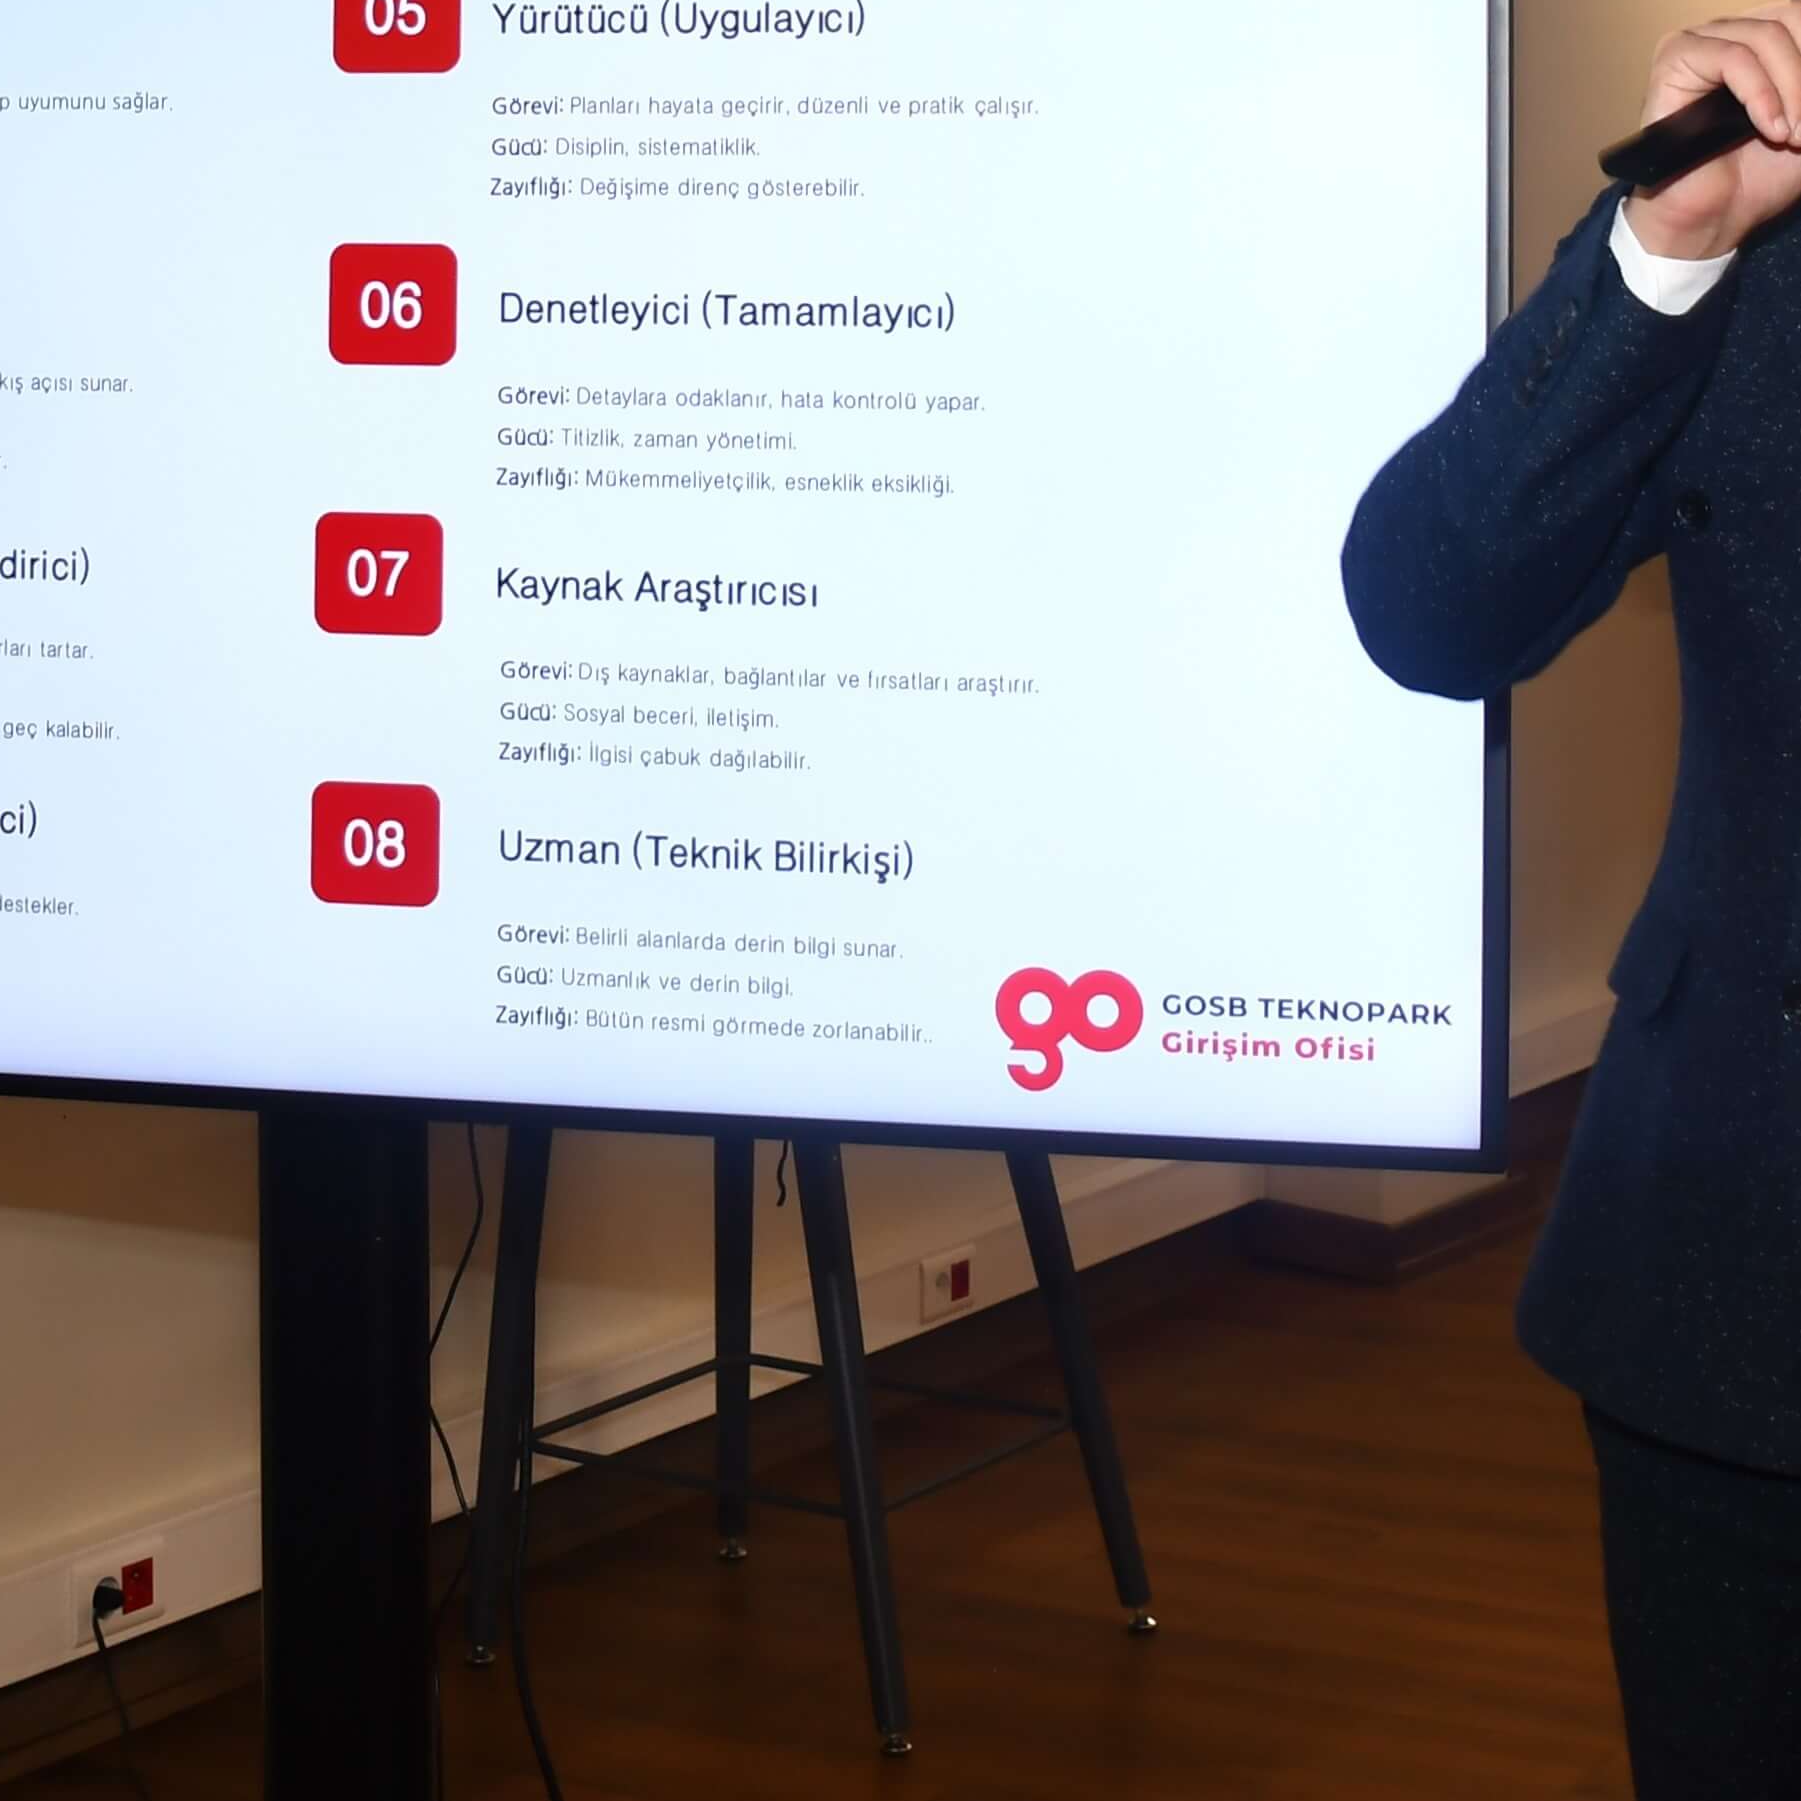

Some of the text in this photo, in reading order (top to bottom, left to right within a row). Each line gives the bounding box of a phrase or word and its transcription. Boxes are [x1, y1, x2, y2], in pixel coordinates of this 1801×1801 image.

[491, 3, 649, 34] Yürütücü
[18, 96, 106, 112] uyumunu
[112, 92, 173, 113] sağlar.
[491, 96, 564, 115] Görevi:
[570, 96, 640, 114] Planları
[648, 96, 714, 117] hayata
[797, 96, 868, 114] düzenli
[877, 100, 902, 114] ve
[908, 96, 965, 117] pratik
[974, 96, 1039, 119] çalışır.
[491, 138, 548, 156] Gücü:
[637, 137, 760, 156] sistematiklik.
[489, 176, 865, 200] Zayıflığı: Değişime direnç gösterebilir.
[360, 280, 422, 329] 06
[499, 289, 955, 334] Denetleyici (Tamamlayıcı)
[497, 386, 570, 405] Görevi:
[576, 387, 667, 408] Detaylara
[780, 390, 825, 408] hata
[832, 391, 917, 410] kontrolü
[925, 396, 985, 413] yapar.
[497, 428, 554, 446] Gücü:
[633, 433, 698, 448] zaman
[706, 432, 797, 452] yönetimi.
[495, 467, 579, 490] Zayıflığı:
[784, 473, 865, 491] esneklik
[871, 474, 955, 498] eksikliği.
[347, 548, 410, 597] 07
[496, 567, 818, 612] Kaynak Araştırıcısı
[2, 722, 38, 739] geç
[46, 720, 120, 739] kalabilir.
[499, 702, 557, 721] Gücü:
[563, 703, 625, 726] Sosyal
[706, 708, 779, 732] iletişim.
[498, 741, 811, 772] Zayıflığı: İlgisi çabuk dağılabilir.
[343, 818, 406, 869] 08
[499, 829, 914, 884] Uzman (Teknik Bilirkişi)
[496, 924, 904, 959] Görevi: Belirli alanlarda derin bilgi sunar.
[496, 965, 793, 999] Gücü: Uzmanlık ve derin bilgi.
[1161, 994, 1453, 1026] GOSB TEKNOPARK
[1161, 1030, 1375, 1062] Girişim Ofisi
